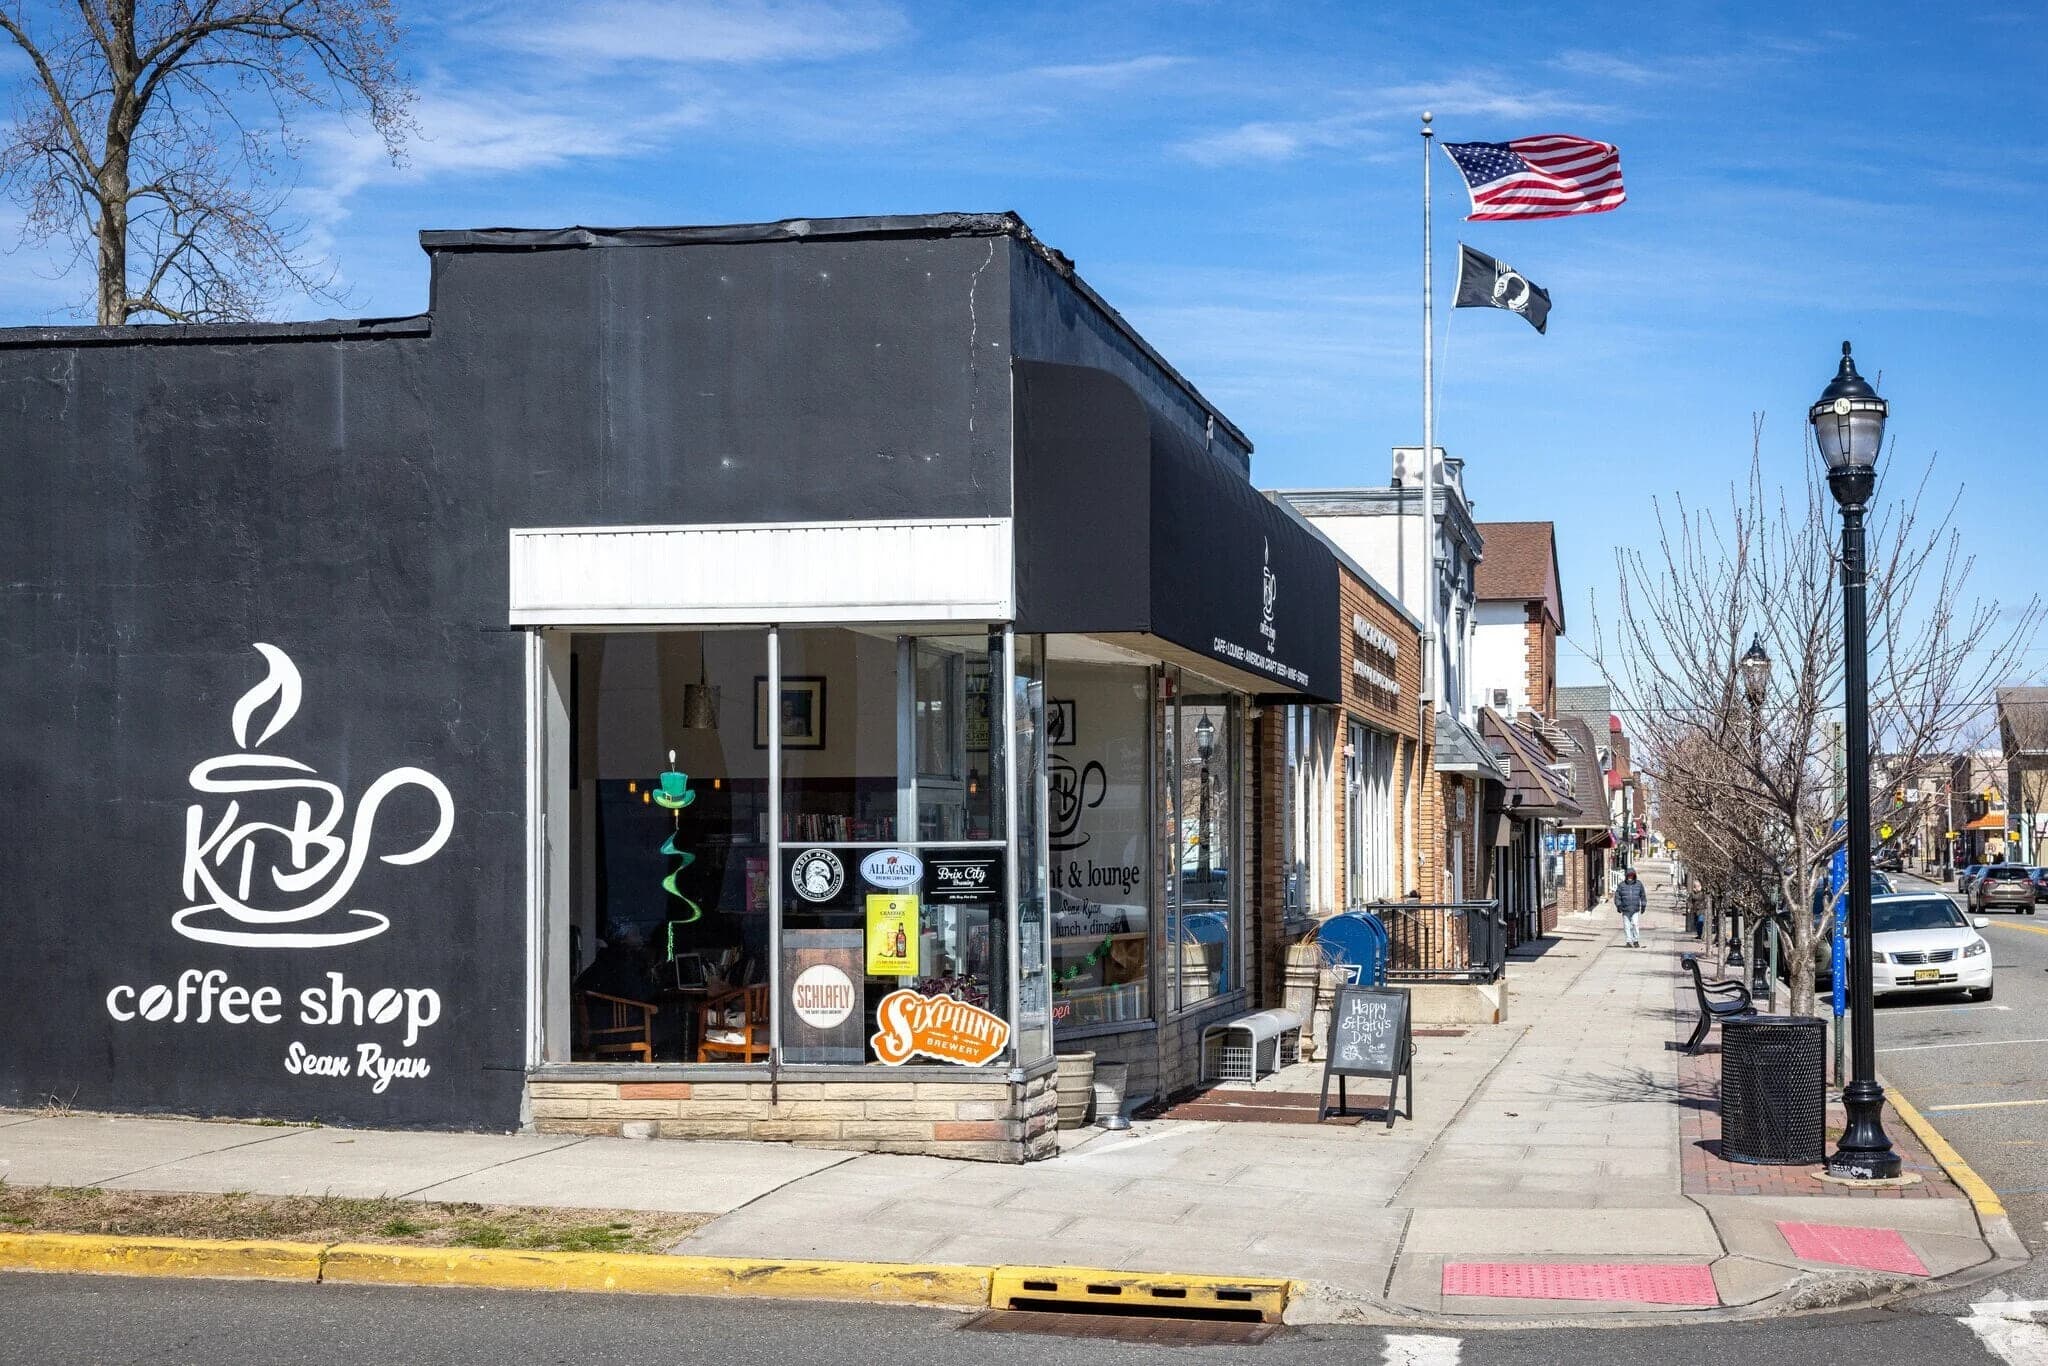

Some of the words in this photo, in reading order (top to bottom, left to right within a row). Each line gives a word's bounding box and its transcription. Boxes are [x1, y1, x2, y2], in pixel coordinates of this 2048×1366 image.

[869, 863, 916, 876] ALLAGASH
[938, 867, 963, 880] Brix
[965, 866, 987, 883] City
[1068, 861, 1083, 888] &
[1087, 860, 1140, 895] lounge
[1056, 921, 1080, 938] lunch
[106, 969, 282, 1023] coffee
[300, 972, 441, 1046] shop
[797, 984, 850, 1009] SCHLAFLY
[1352, 998, 1387, 1020] Happy
[1350, 1030, 1372, 1045] Day
[1356, 1015, 1391, 1038] Patty's
[927, 1037, 980, 1056] BREWERY
[285, 1041, 351, 1076] Sean
[357, 1043, 430, 1094] Ryan
